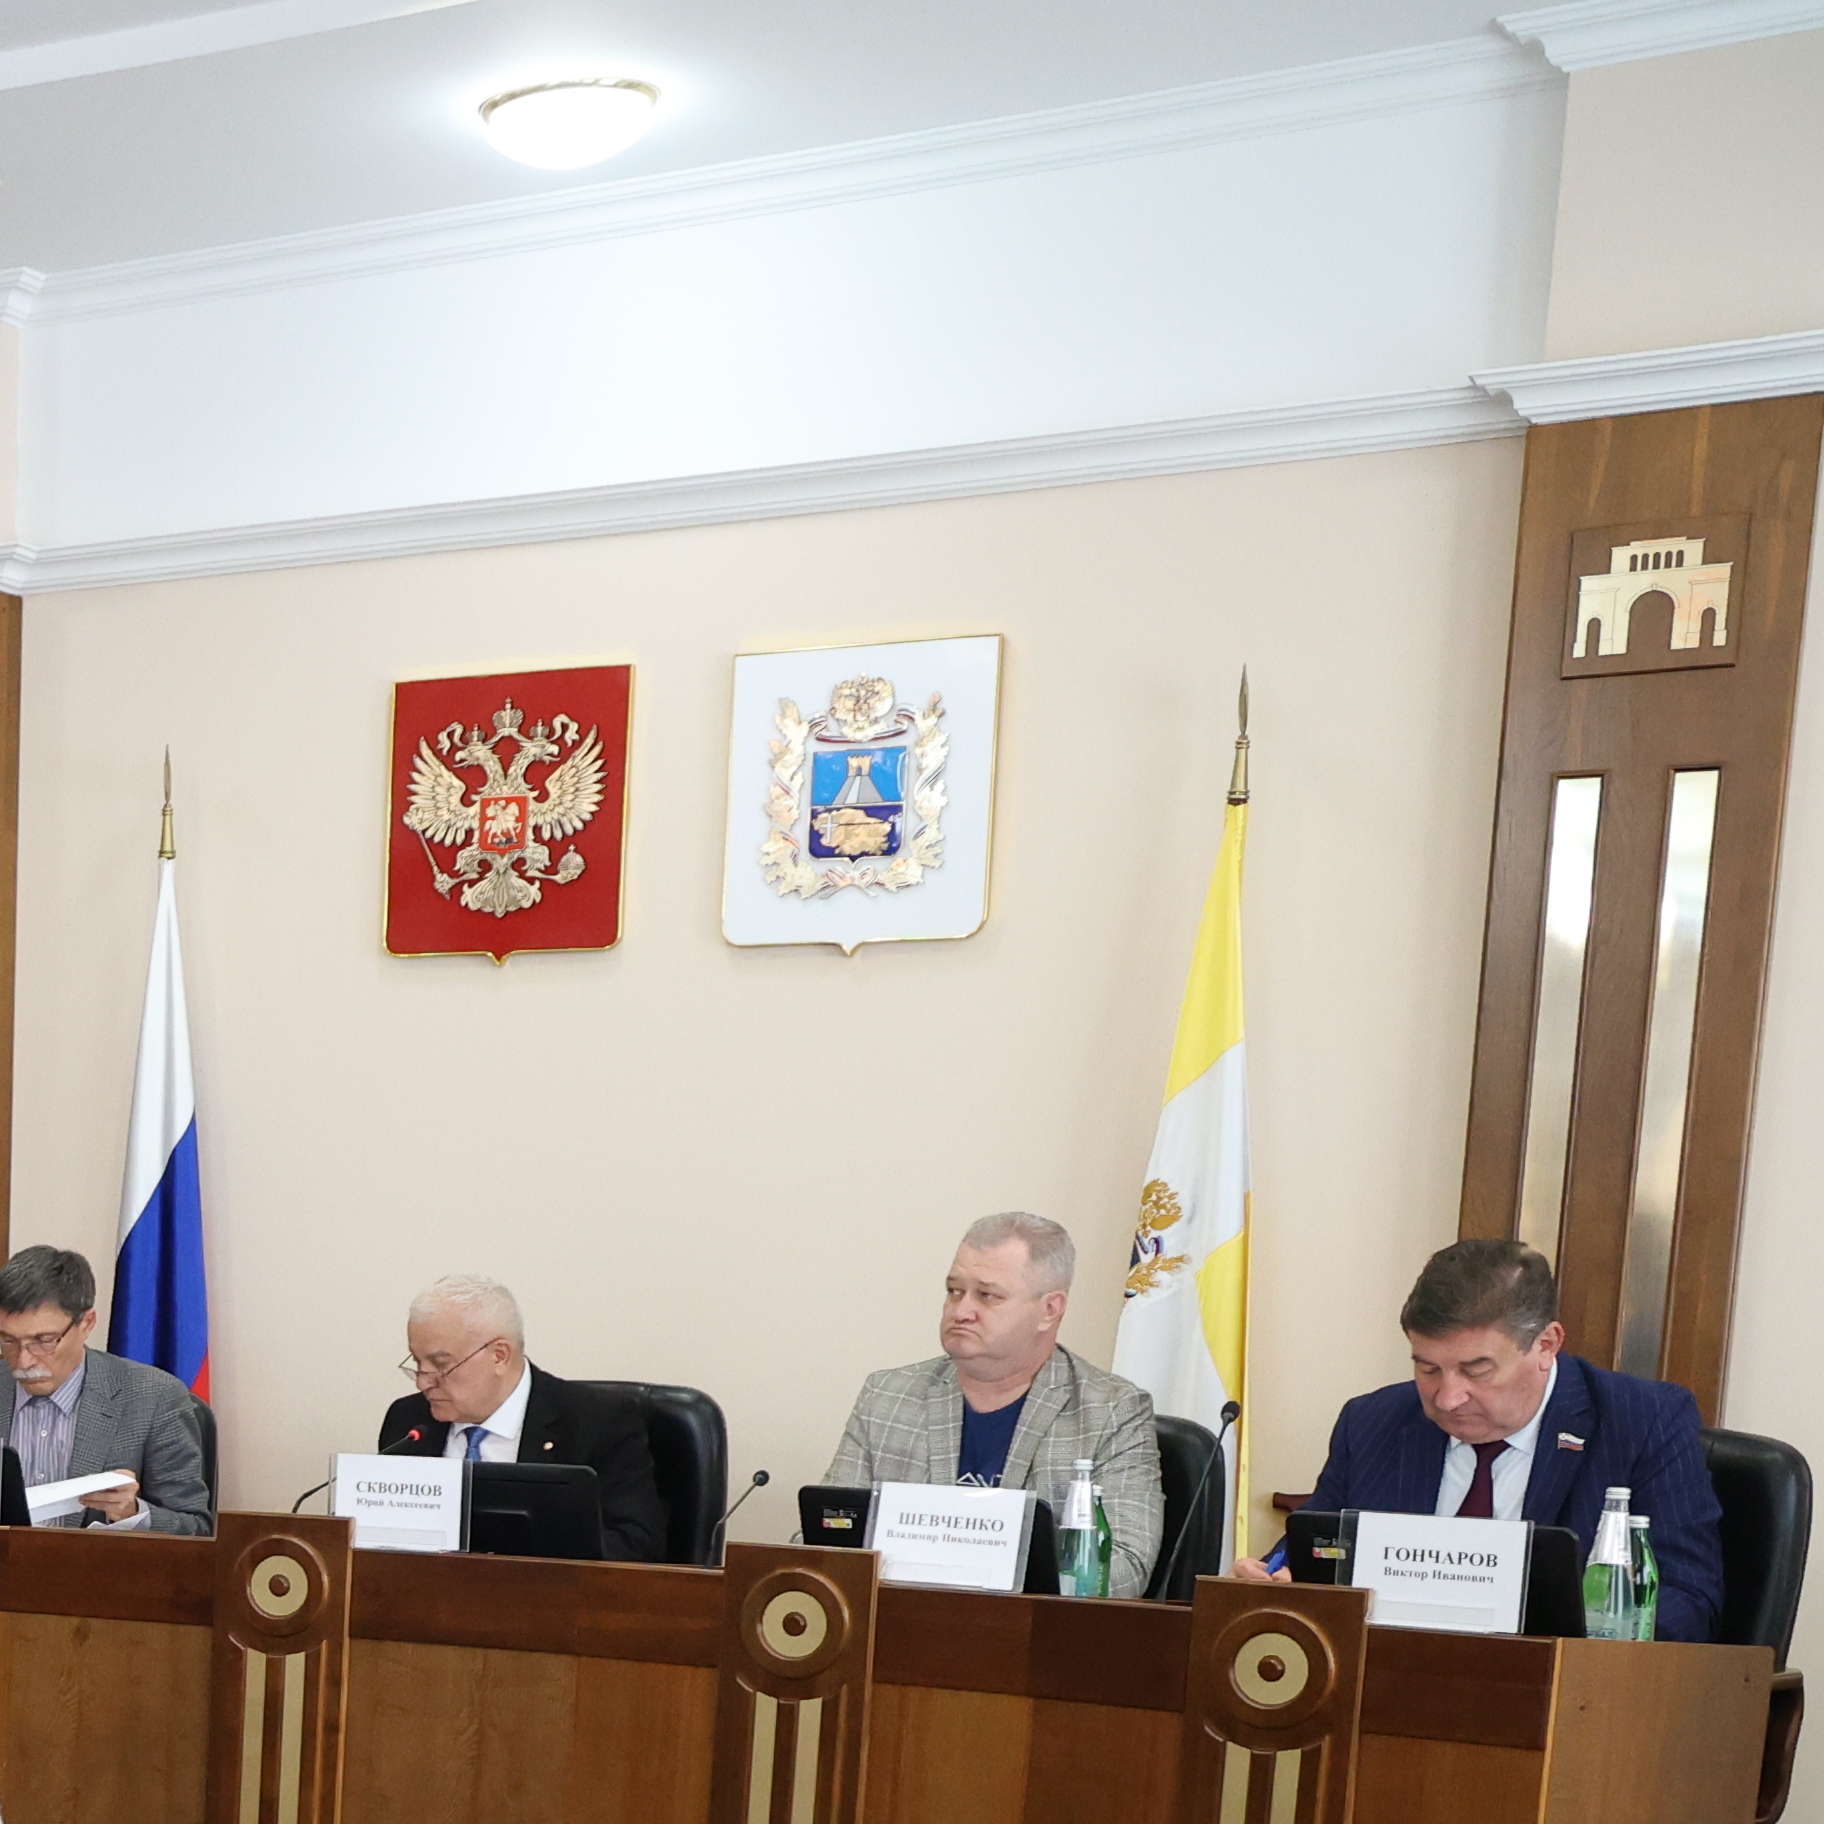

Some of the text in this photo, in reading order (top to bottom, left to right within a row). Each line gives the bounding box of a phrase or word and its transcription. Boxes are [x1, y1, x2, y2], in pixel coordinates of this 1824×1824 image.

[356, 1480, 443, 1497] СКВОРЦОВ
[356, 1498, 384, 1508] Юрий
[898, 1512, 1005, 1533] ШЕВЧЕНКО
[886, 1529, 1008, 1547] Владимир Николаевич
[1383, 1546, 1498, 1568] ГОНЧАРОВ
[1383, 1566, 1494, 1584] Виктор Иванович
